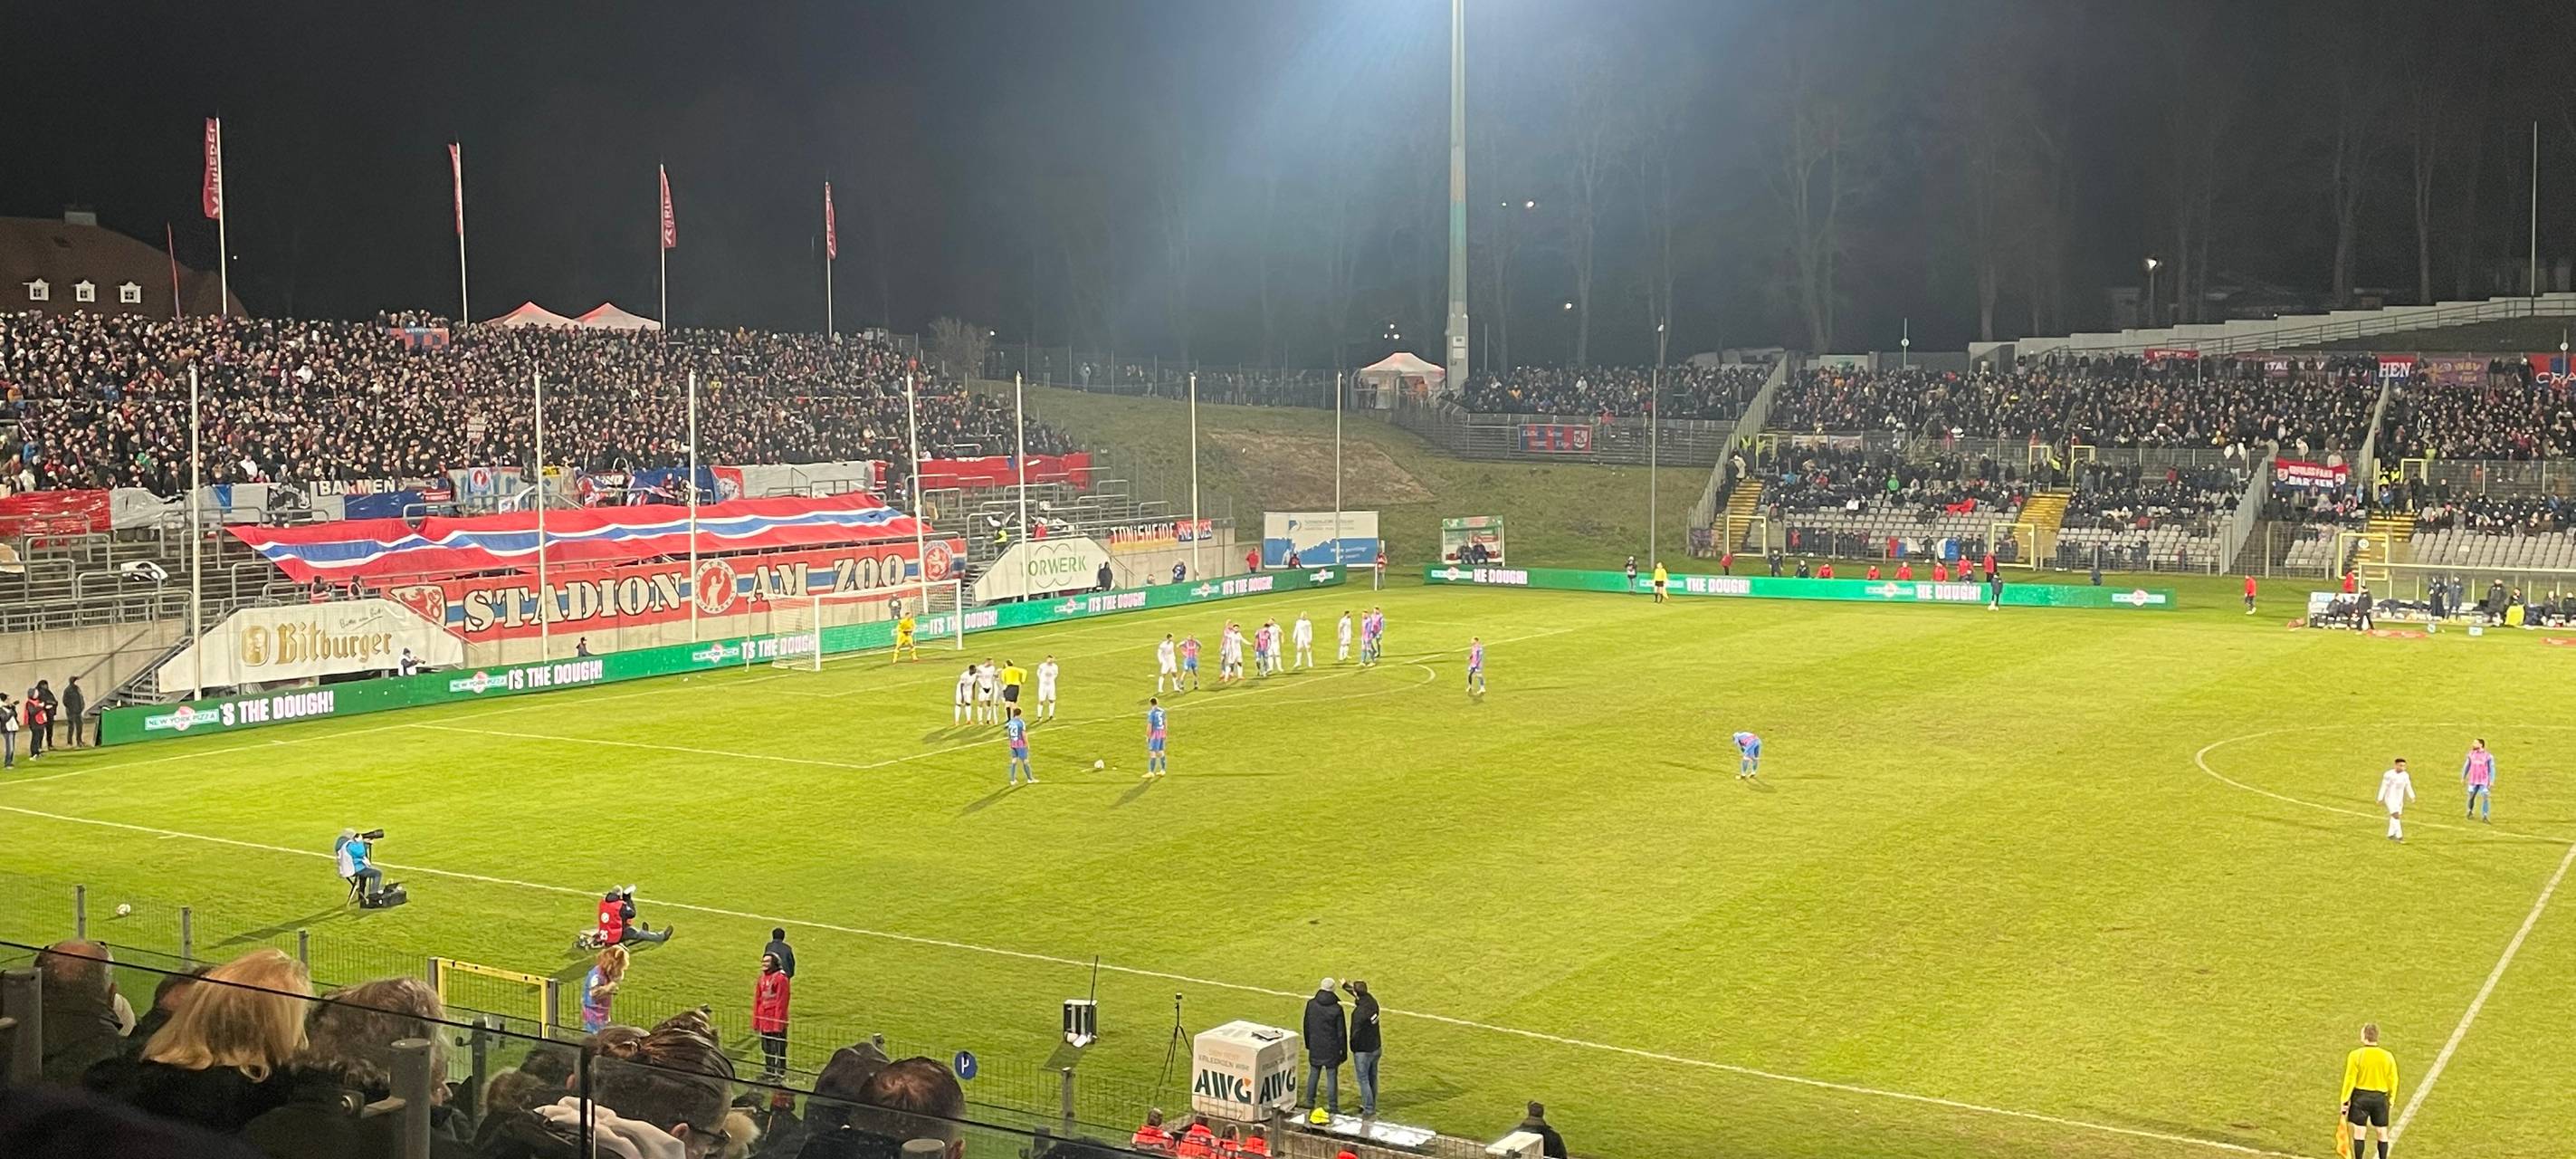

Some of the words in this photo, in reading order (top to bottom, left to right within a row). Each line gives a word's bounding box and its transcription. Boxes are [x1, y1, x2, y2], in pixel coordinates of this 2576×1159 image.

[319, 477, 396, 495] BARMEN
[747, 562, 809, 603] AM
[834, 554, 906, 592] ZOO
[463, 571, 682, 633] STADION
[1102, 594, 1117, 610] THE
[964, 609, 998, 629] DOUGH!
[275, 621, 392, 666] Bitburger
[758, 639, 778, 657] THE
[526, 666, 551, 688] THE
[554, 660, 603, 685] DOUGH!
[238, 698, 270, 723] THE
[272, 691, 335, 721] DOUGH!
[1194, 1068, 1252, 1105] AWG
[1259, 1066, 1297, 1105] AWG
